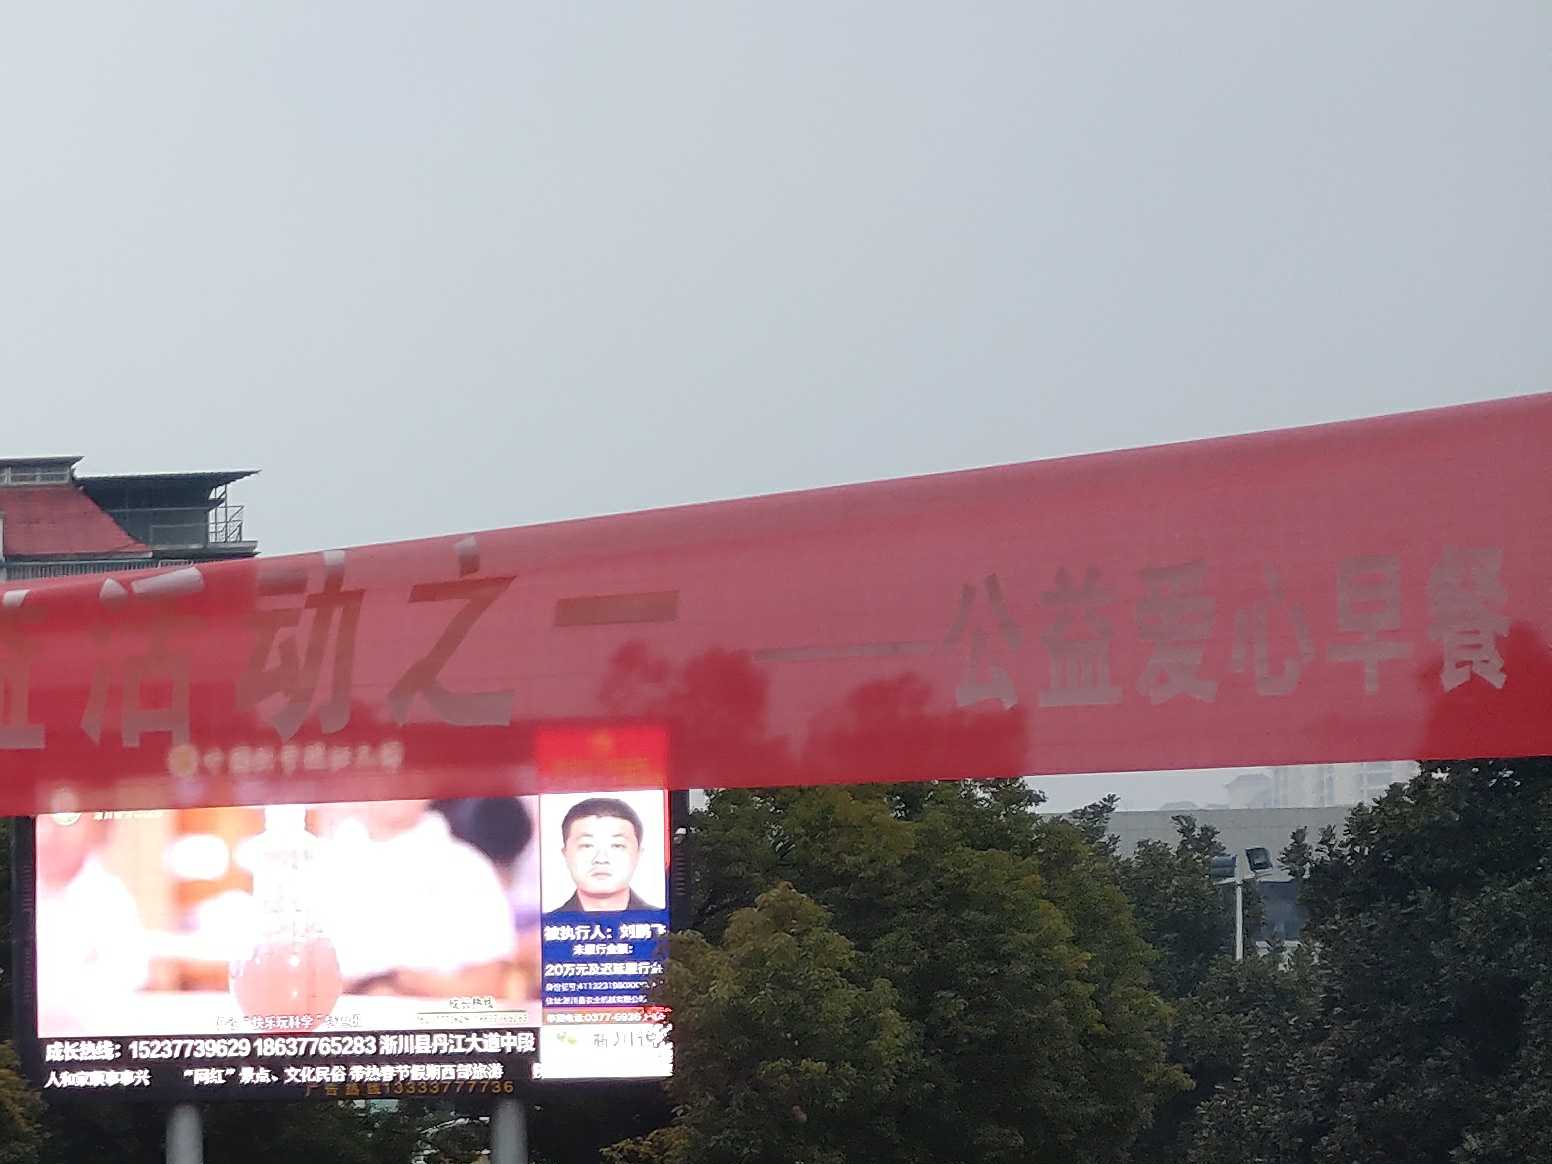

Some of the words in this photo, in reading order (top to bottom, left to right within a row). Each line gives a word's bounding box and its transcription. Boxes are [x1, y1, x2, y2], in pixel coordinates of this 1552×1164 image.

[129, 1038, 251, 1059] 15237739629
[256, 1036, 377, 1057] 18637765283
[379, 1031, 537, 1056] 淅川县丹江大道中段
